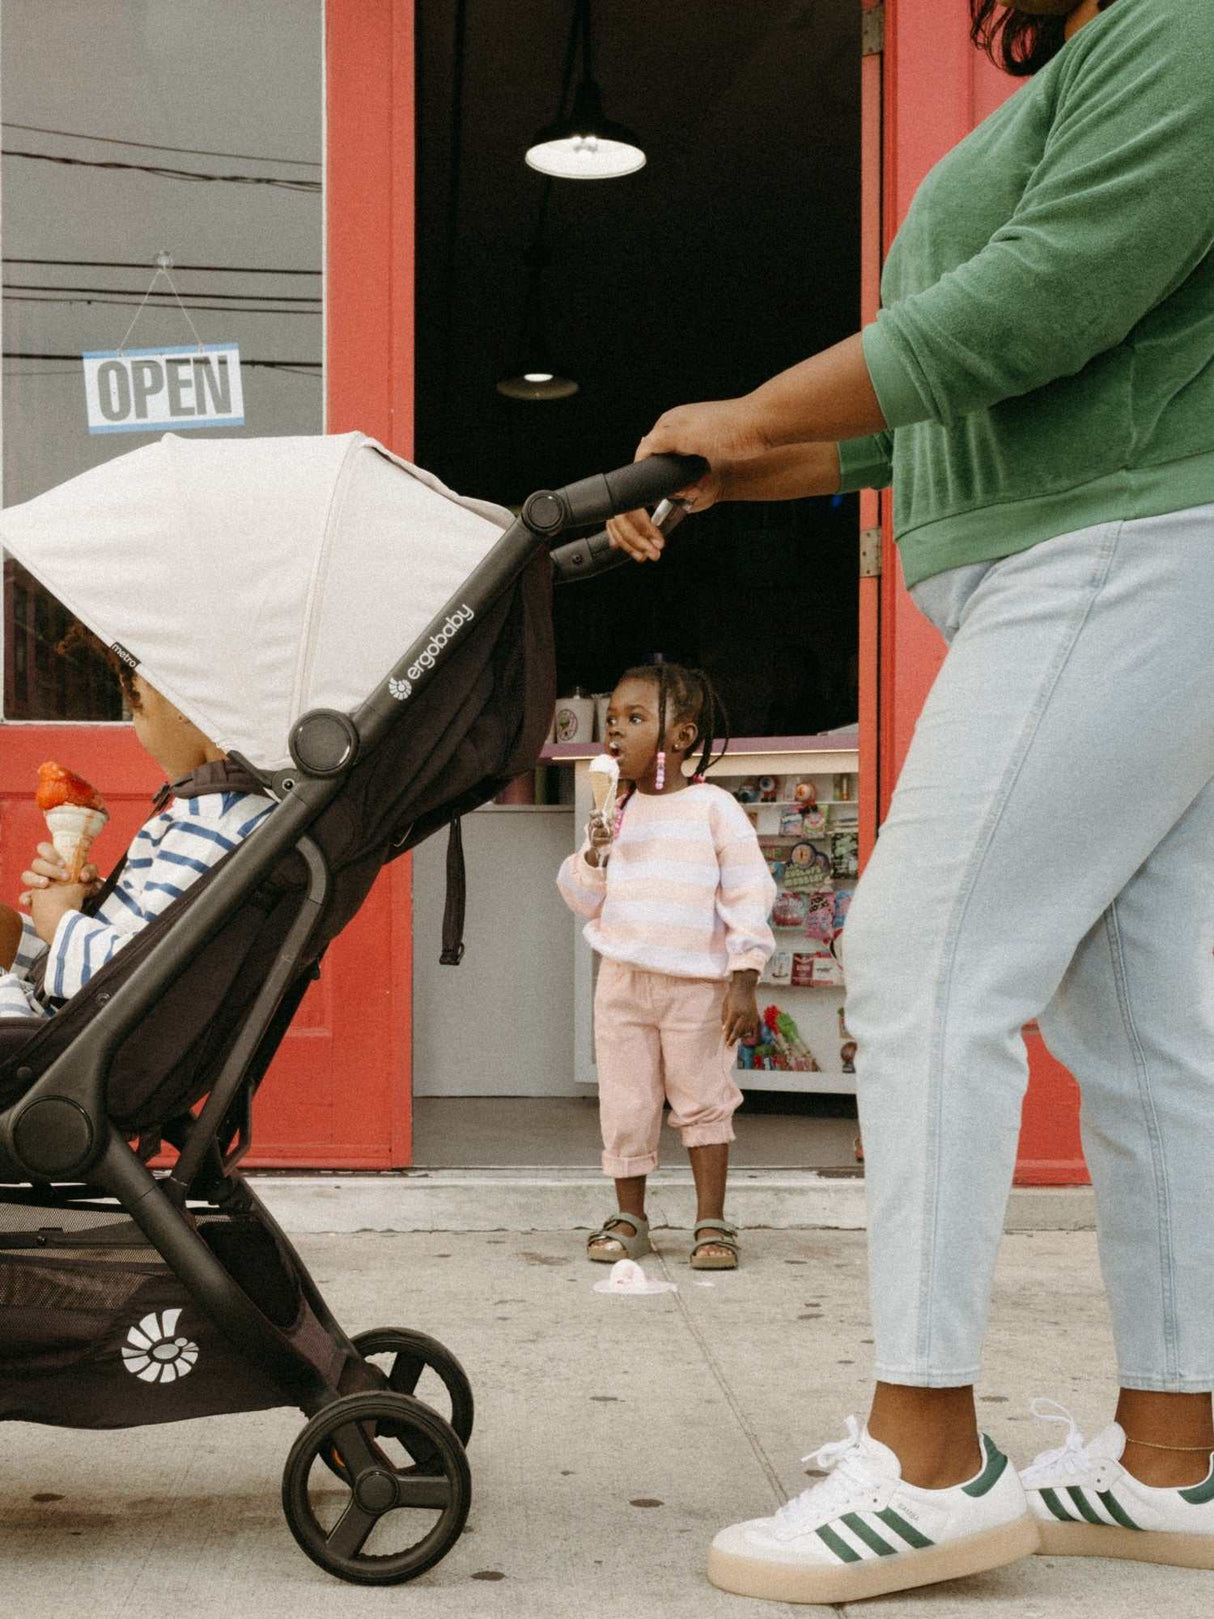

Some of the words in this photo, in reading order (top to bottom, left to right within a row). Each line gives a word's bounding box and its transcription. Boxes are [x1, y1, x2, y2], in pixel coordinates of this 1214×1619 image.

[97, 355, 232, 422] OPEN
[111, 643, 137, 668] metro
[407, 603, 475, 680] ergobaby
